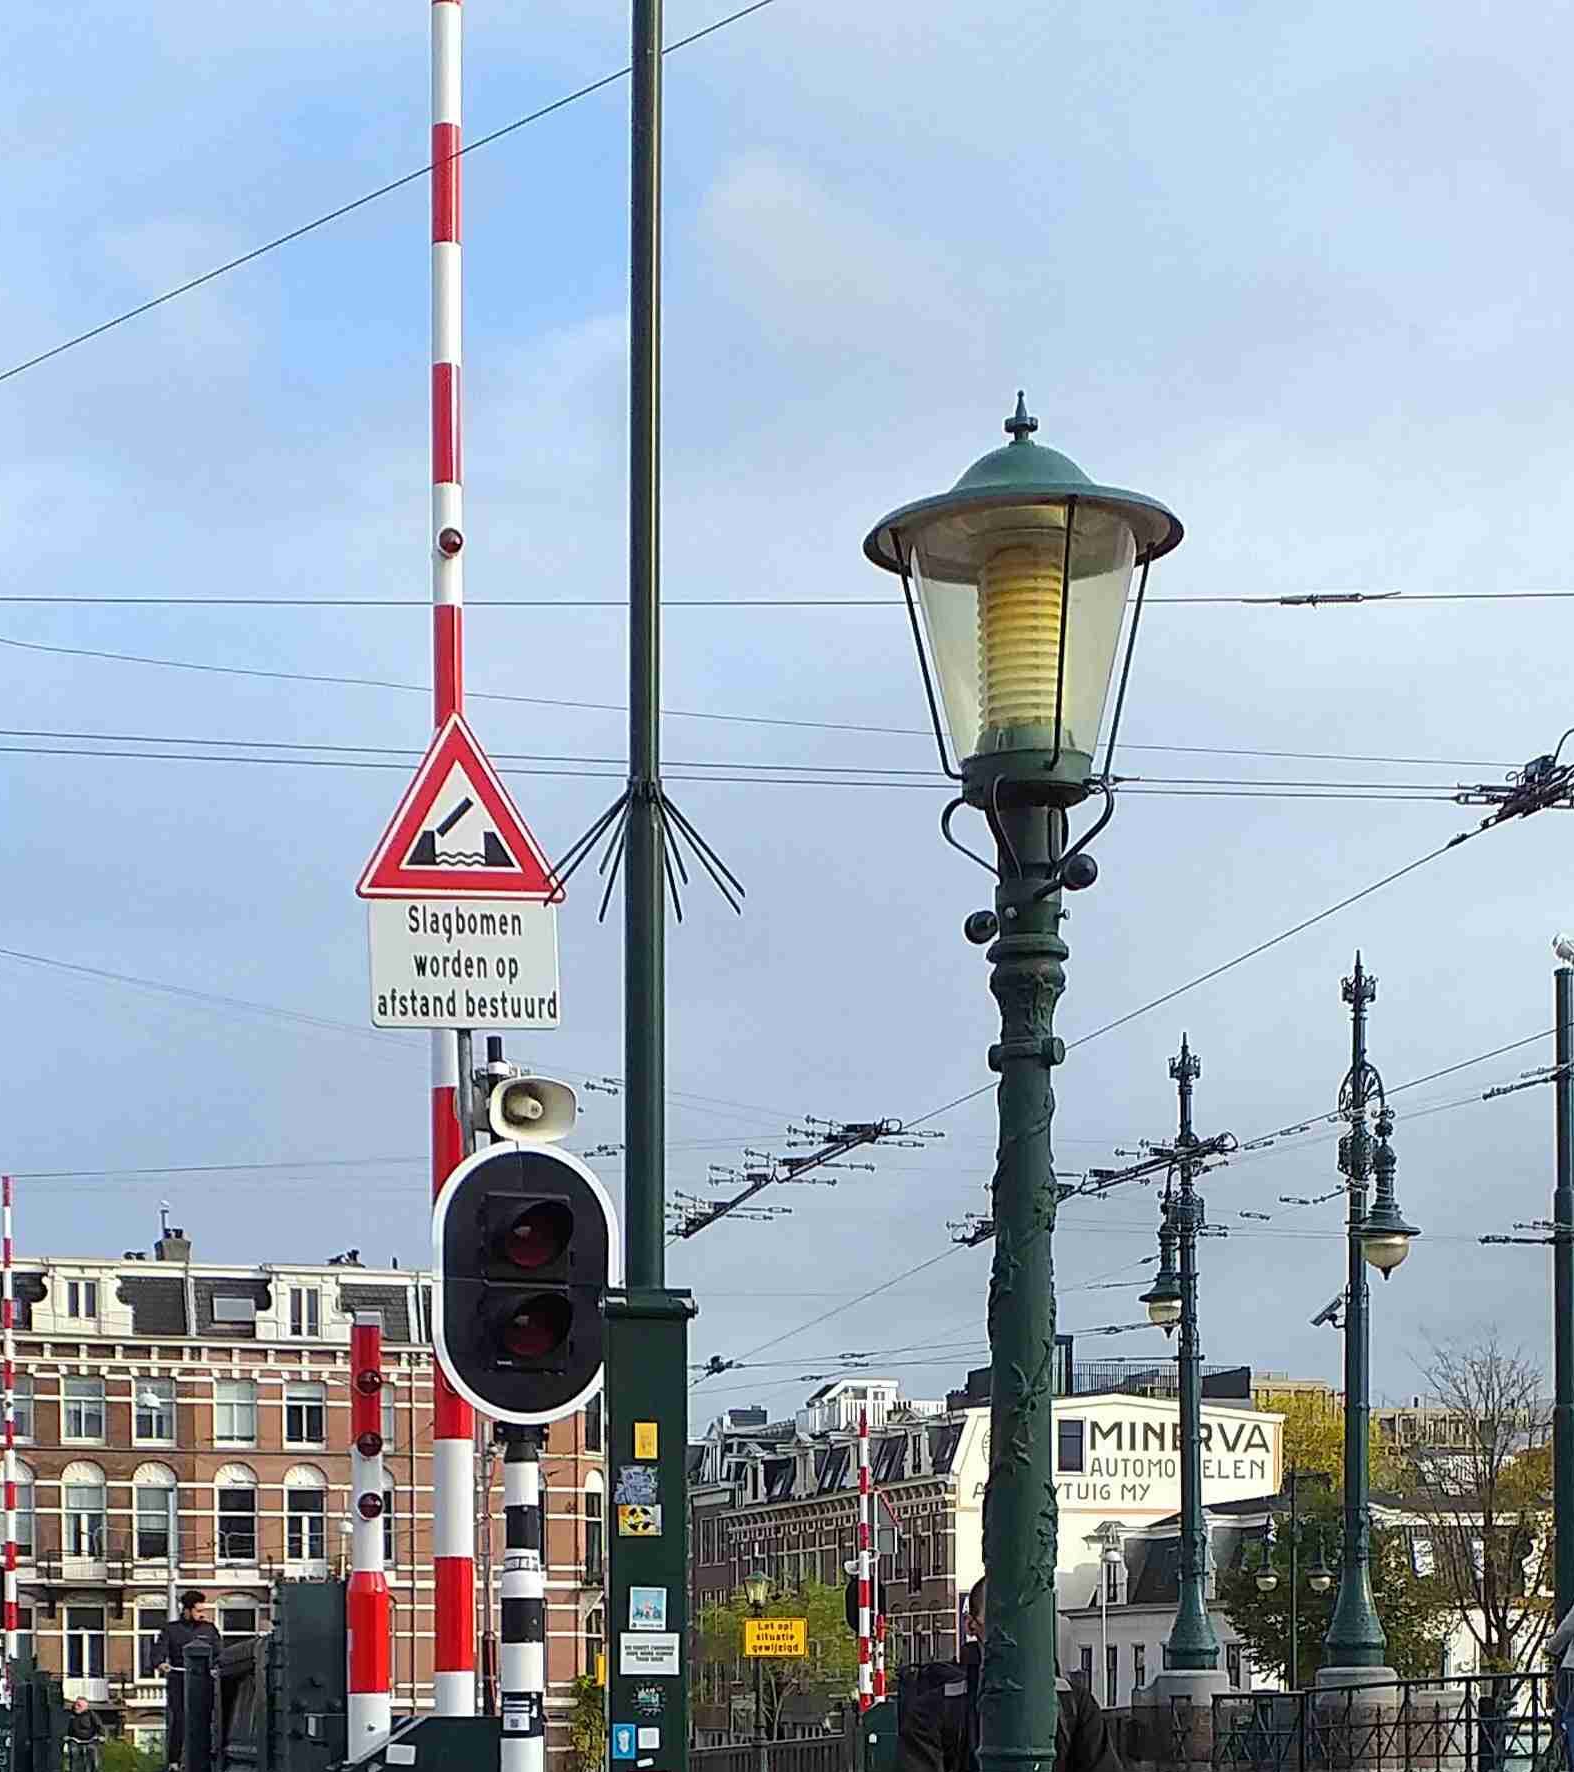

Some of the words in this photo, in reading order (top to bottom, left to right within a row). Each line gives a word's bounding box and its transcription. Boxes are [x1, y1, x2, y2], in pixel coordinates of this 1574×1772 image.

[408, 905, 523, 943] Slagbomen
[413, 950, 488, 979] worden
[495, 958, 519, 984] op
[377, 988, 457, 1017] afstand
[466, 990, 558, 1020] bestuurd
[1089, 1457, 1266, 1480] AUTOMOELEN
[1120, 1482, 1151, 1501] MY
[756, 1632, 795, 1641] situatie
[757, 1621, 774, 1631] Let
